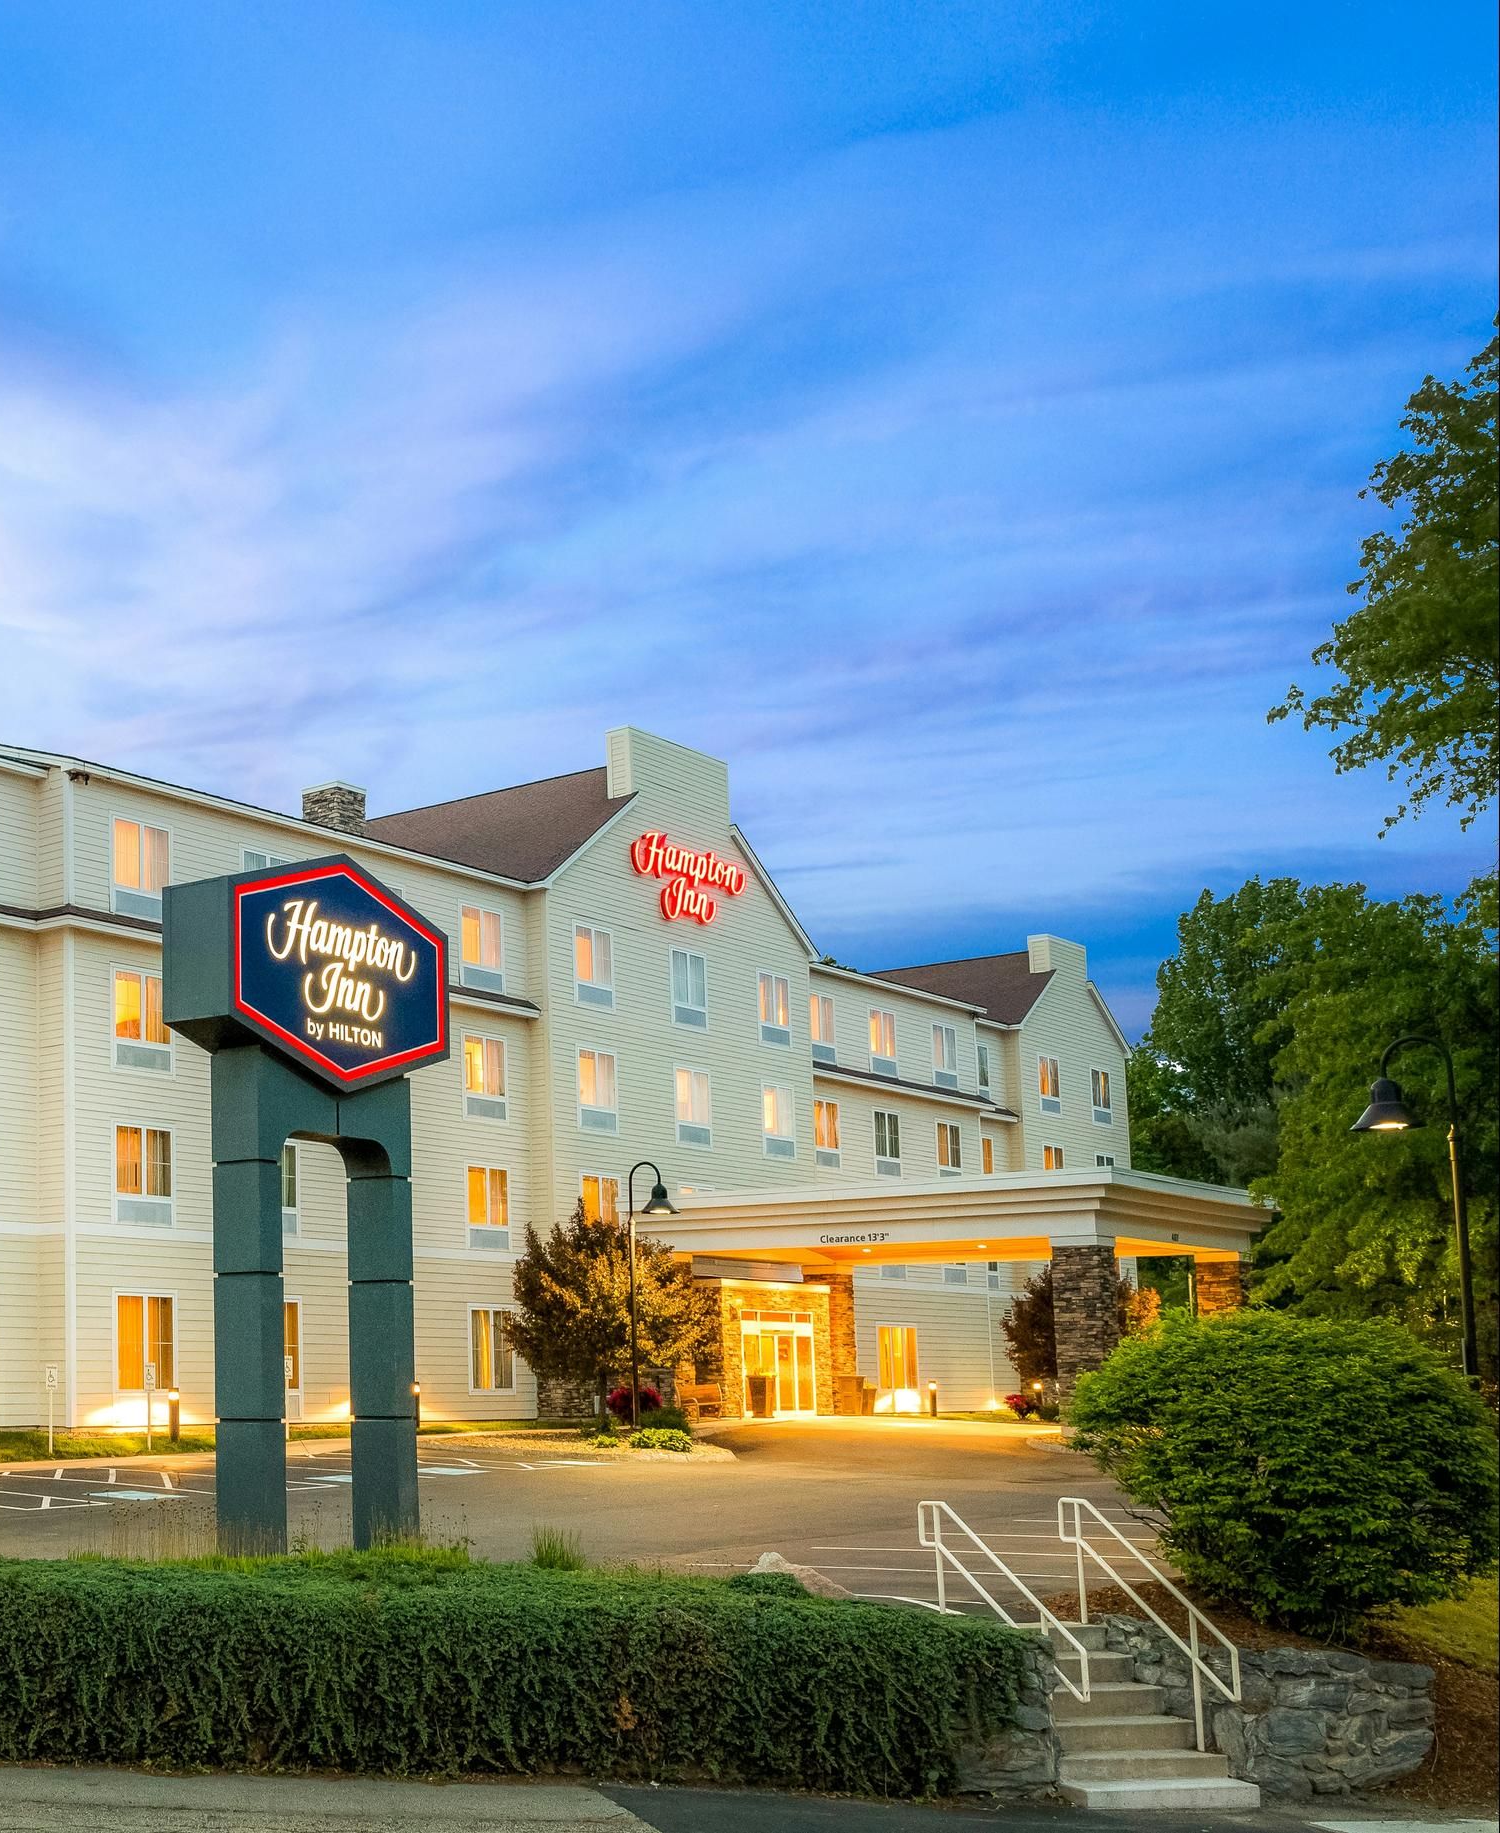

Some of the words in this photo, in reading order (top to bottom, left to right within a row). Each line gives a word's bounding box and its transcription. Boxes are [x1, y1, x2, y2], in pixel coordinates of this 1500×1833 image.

[630, 831, 746, 895] Hampton
[661, 877, 717, 924] Inn
[267, 900, 416, 982] Hampton
[305, 962, 384, 1022] Inn
[307, 1018, 325, 1040] by
[329, 1022, 382, 1048] HILTON
[820, 1234, 866, 1244] Clearance
[867, 1232, 890, 1242] 13'3"
